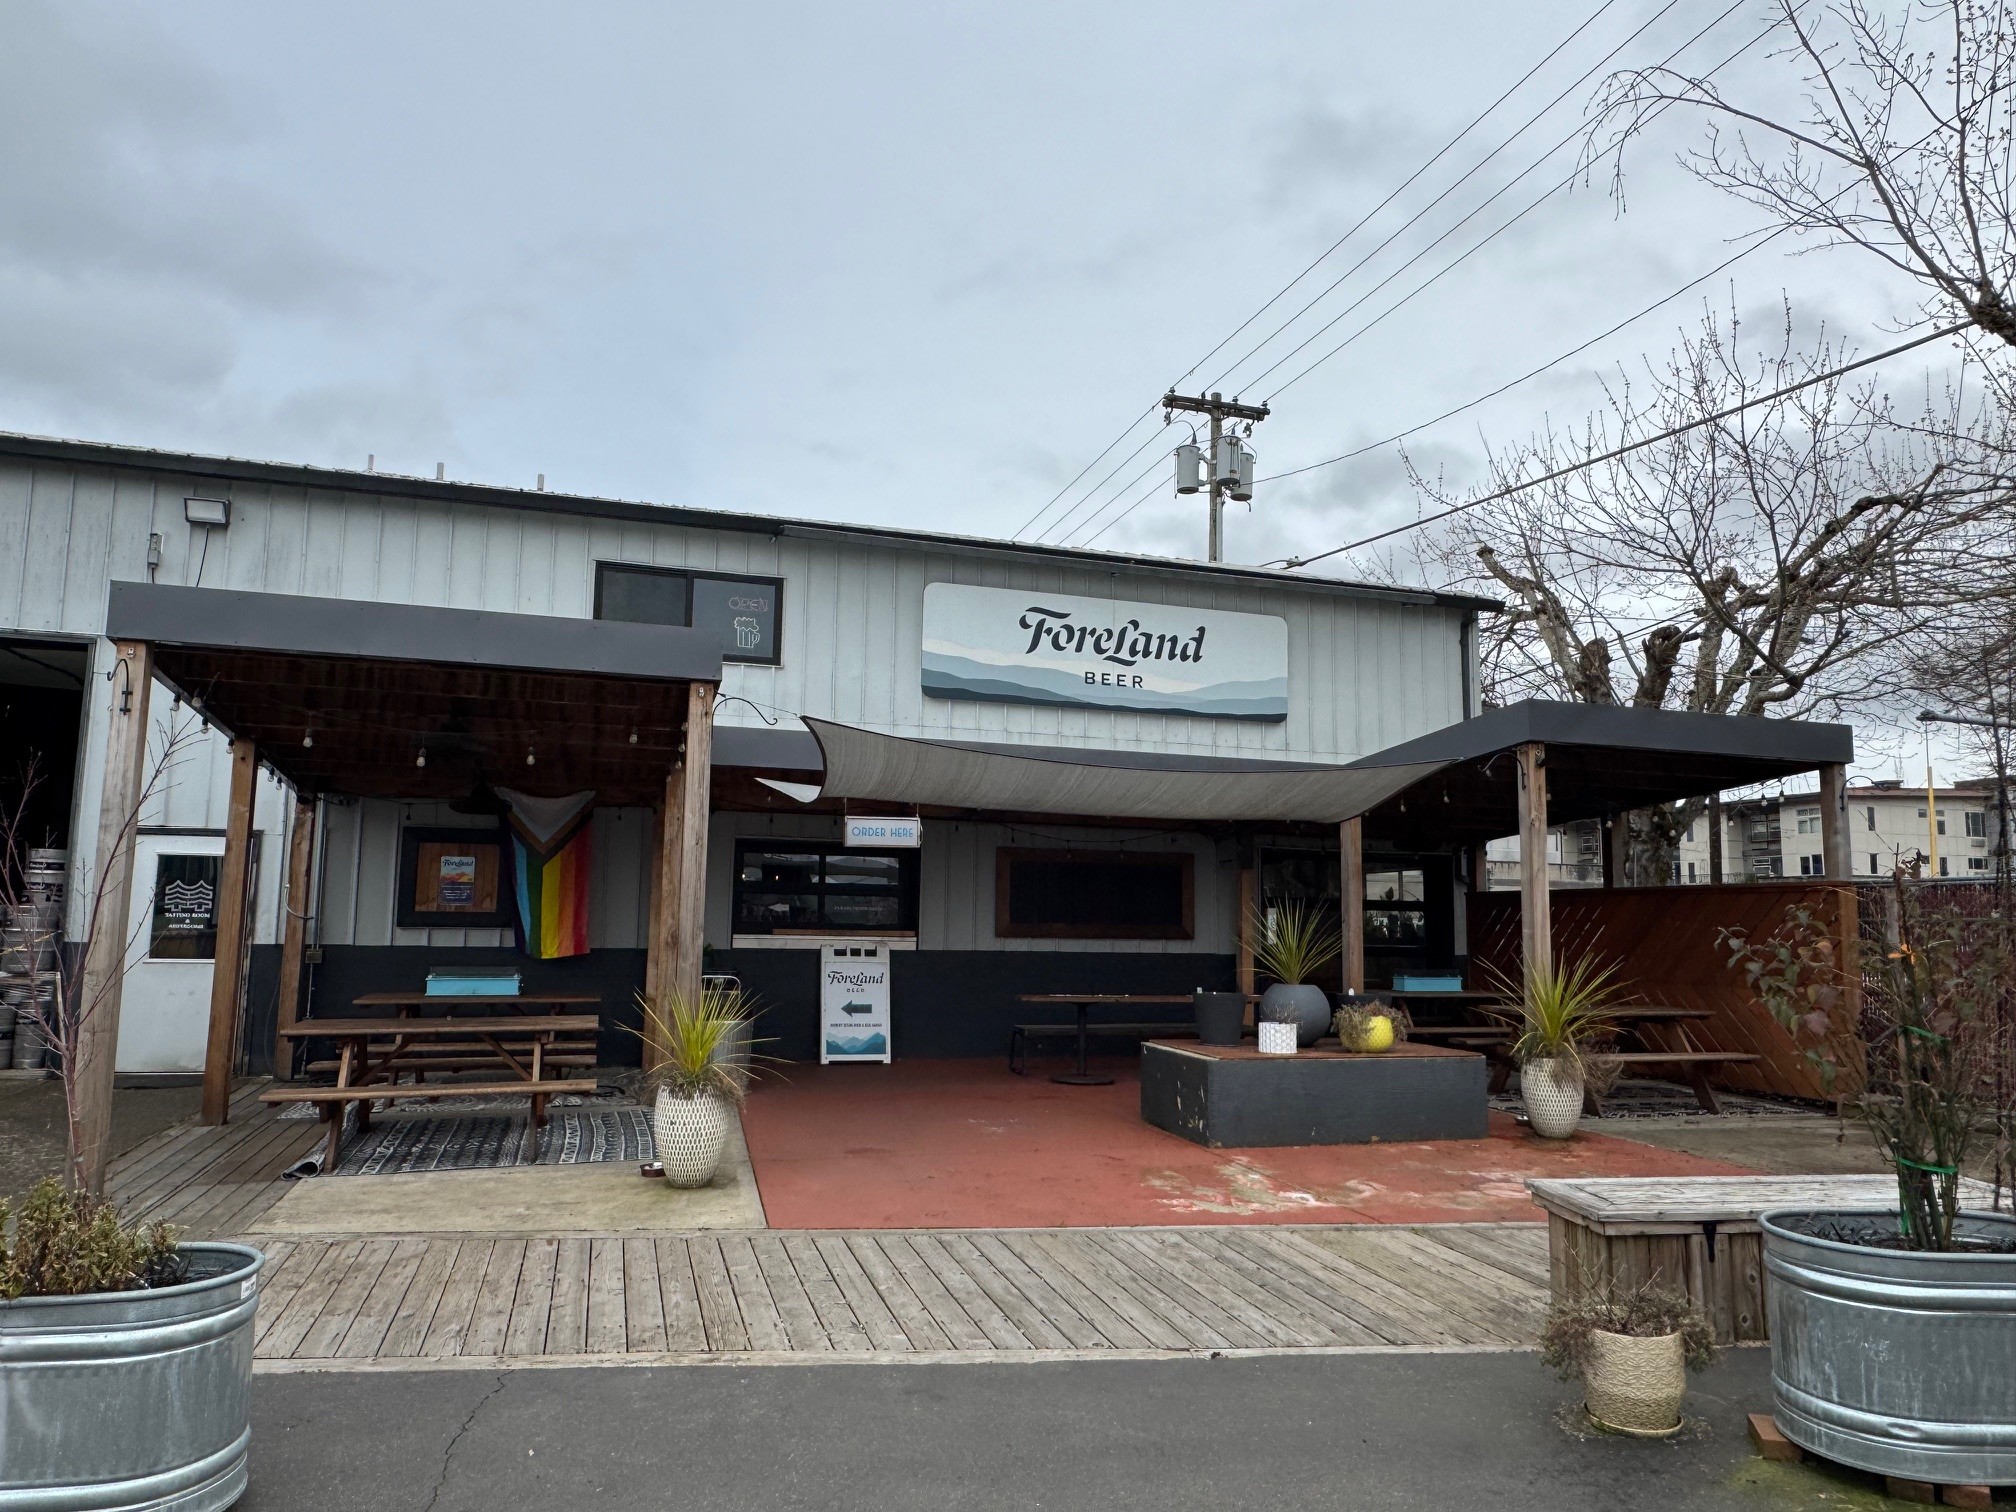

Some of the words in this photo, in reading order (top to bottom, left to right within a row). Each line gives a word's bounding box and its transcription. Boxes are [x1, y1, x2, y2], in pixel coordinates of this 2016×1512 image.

[728, 596, 769, 612] OPEN
[1084, 671, 1144, 689] BEER
[851, 826, 886, 837] ORDER
[890, 827, 914, 838] HERE
